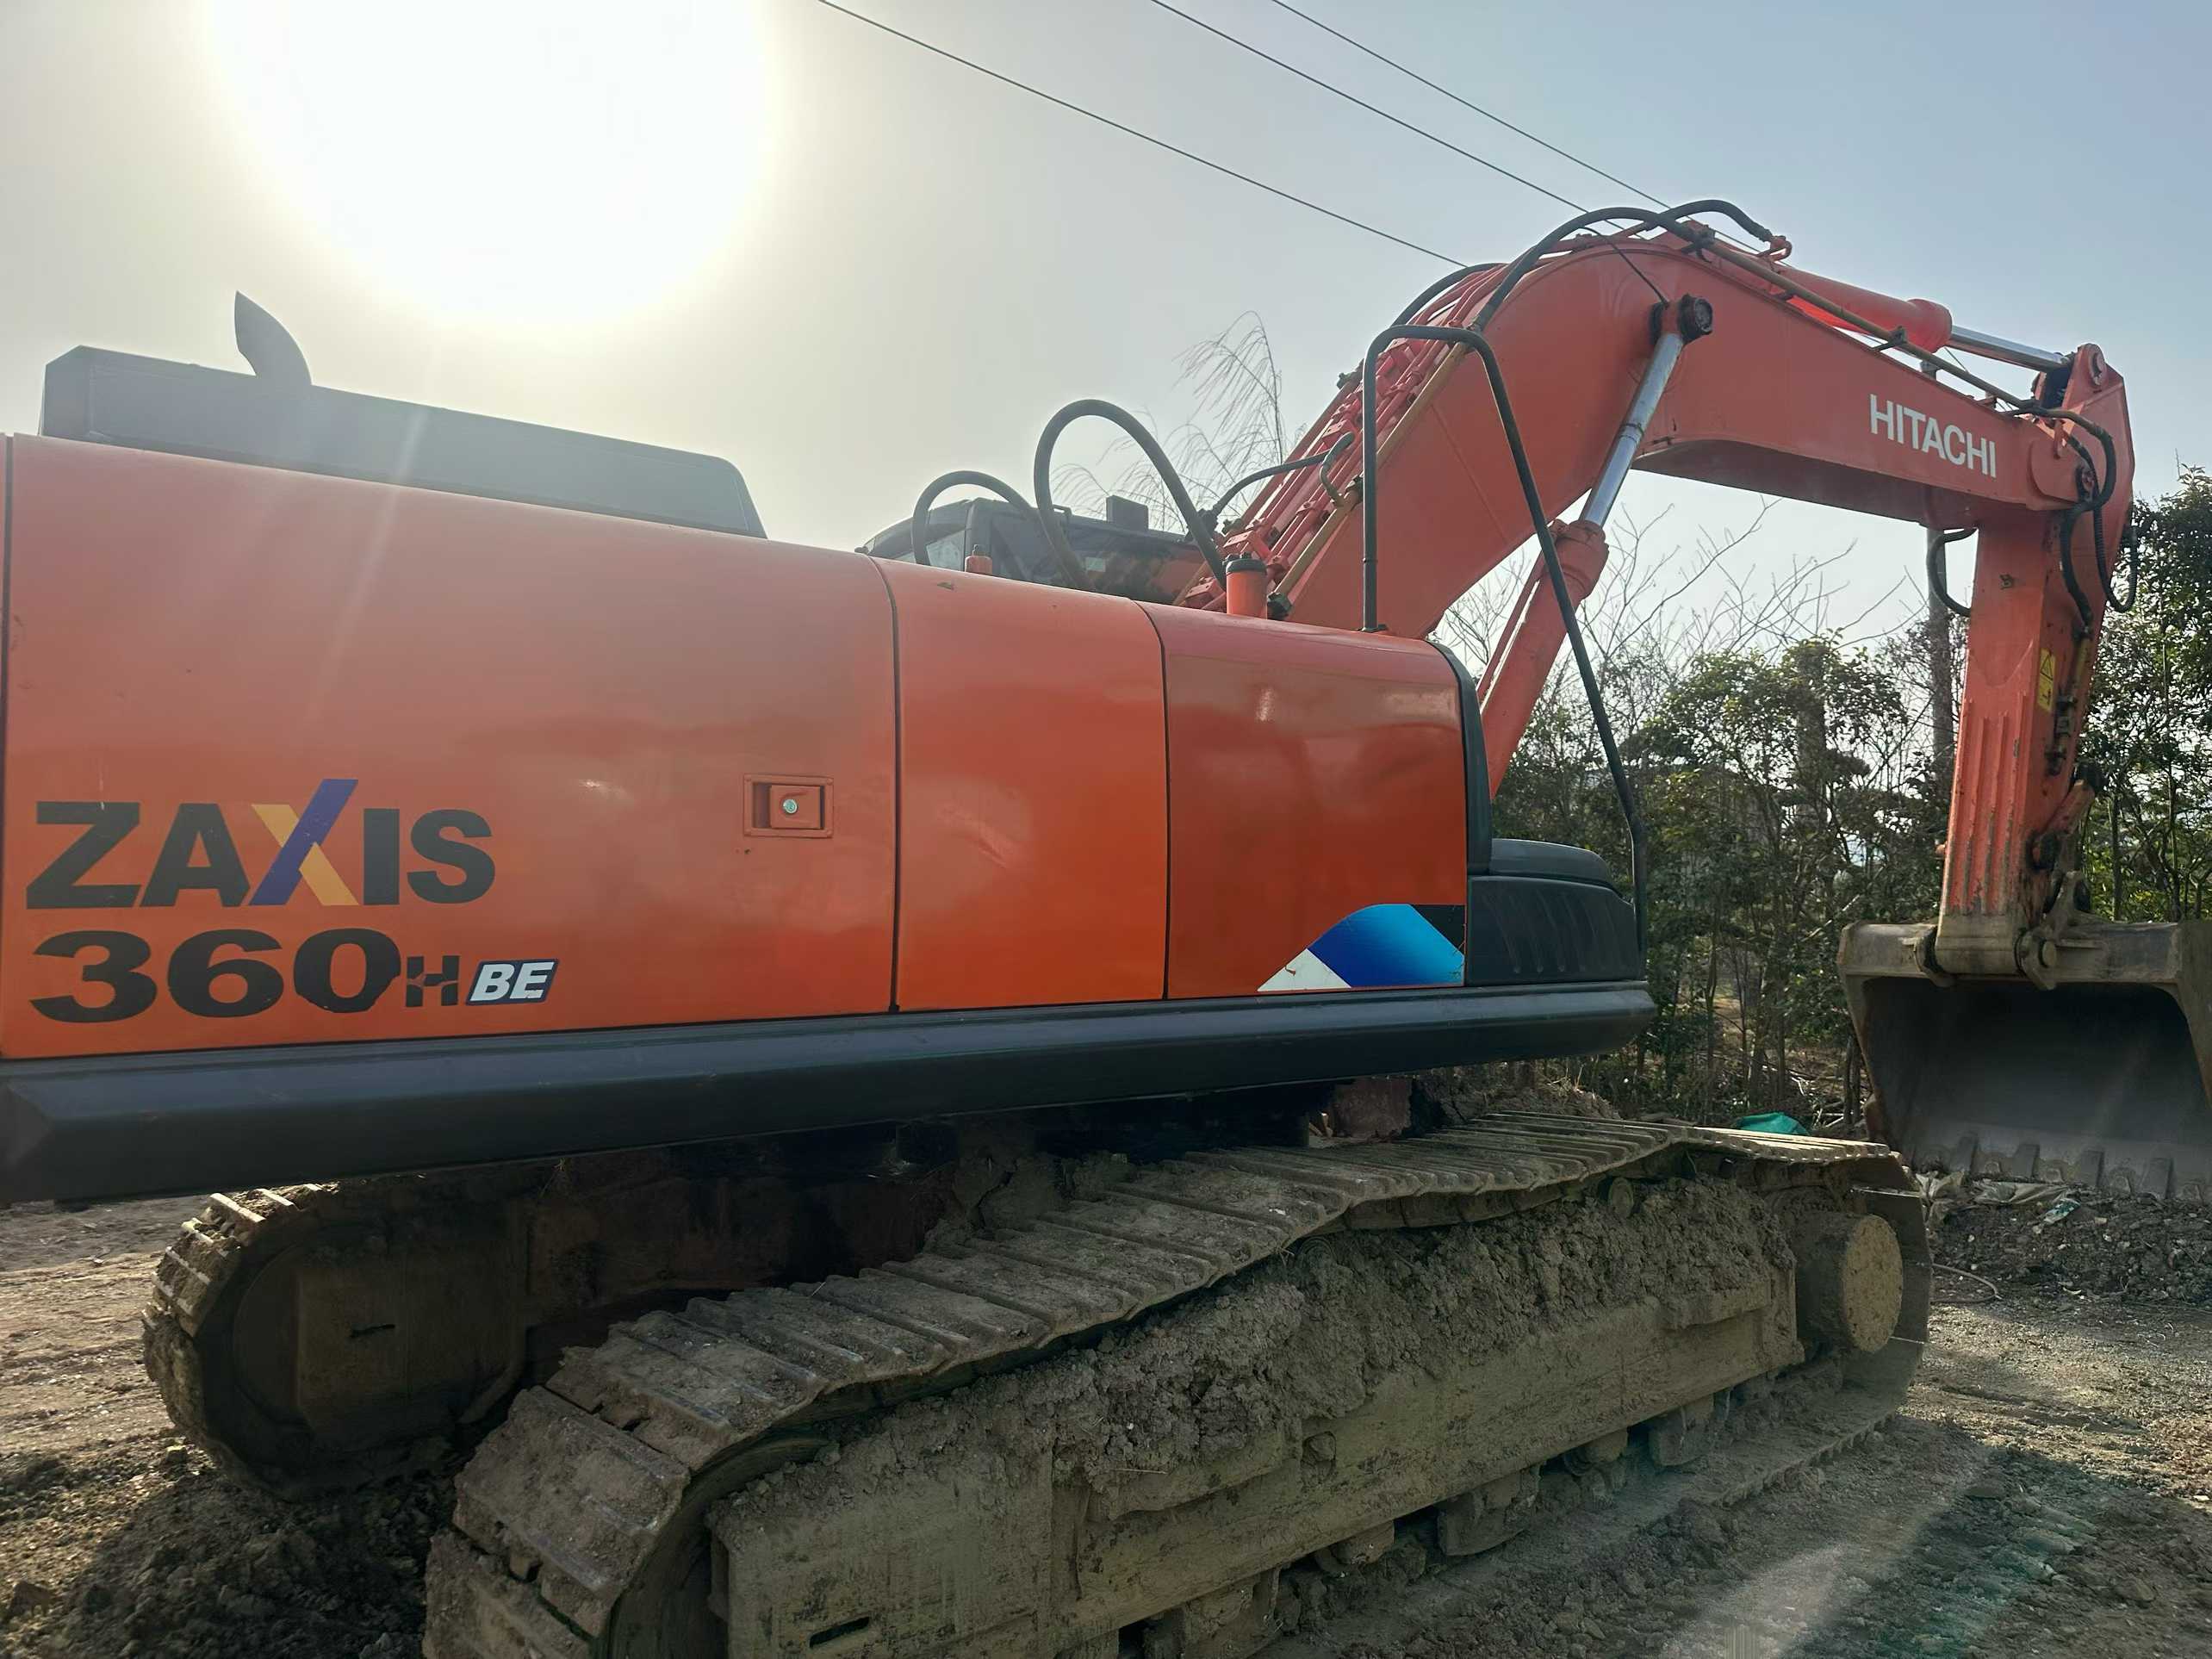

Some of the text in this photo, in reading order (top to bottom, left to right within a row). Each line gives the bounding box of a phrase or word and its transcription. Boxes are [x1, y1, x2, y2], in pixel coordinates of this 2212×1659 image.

[1870, 394, 1997, 478] HITACHI
[26, 779, 495, 910] ZAXIS
[469, 960, 555, 1002] BE
